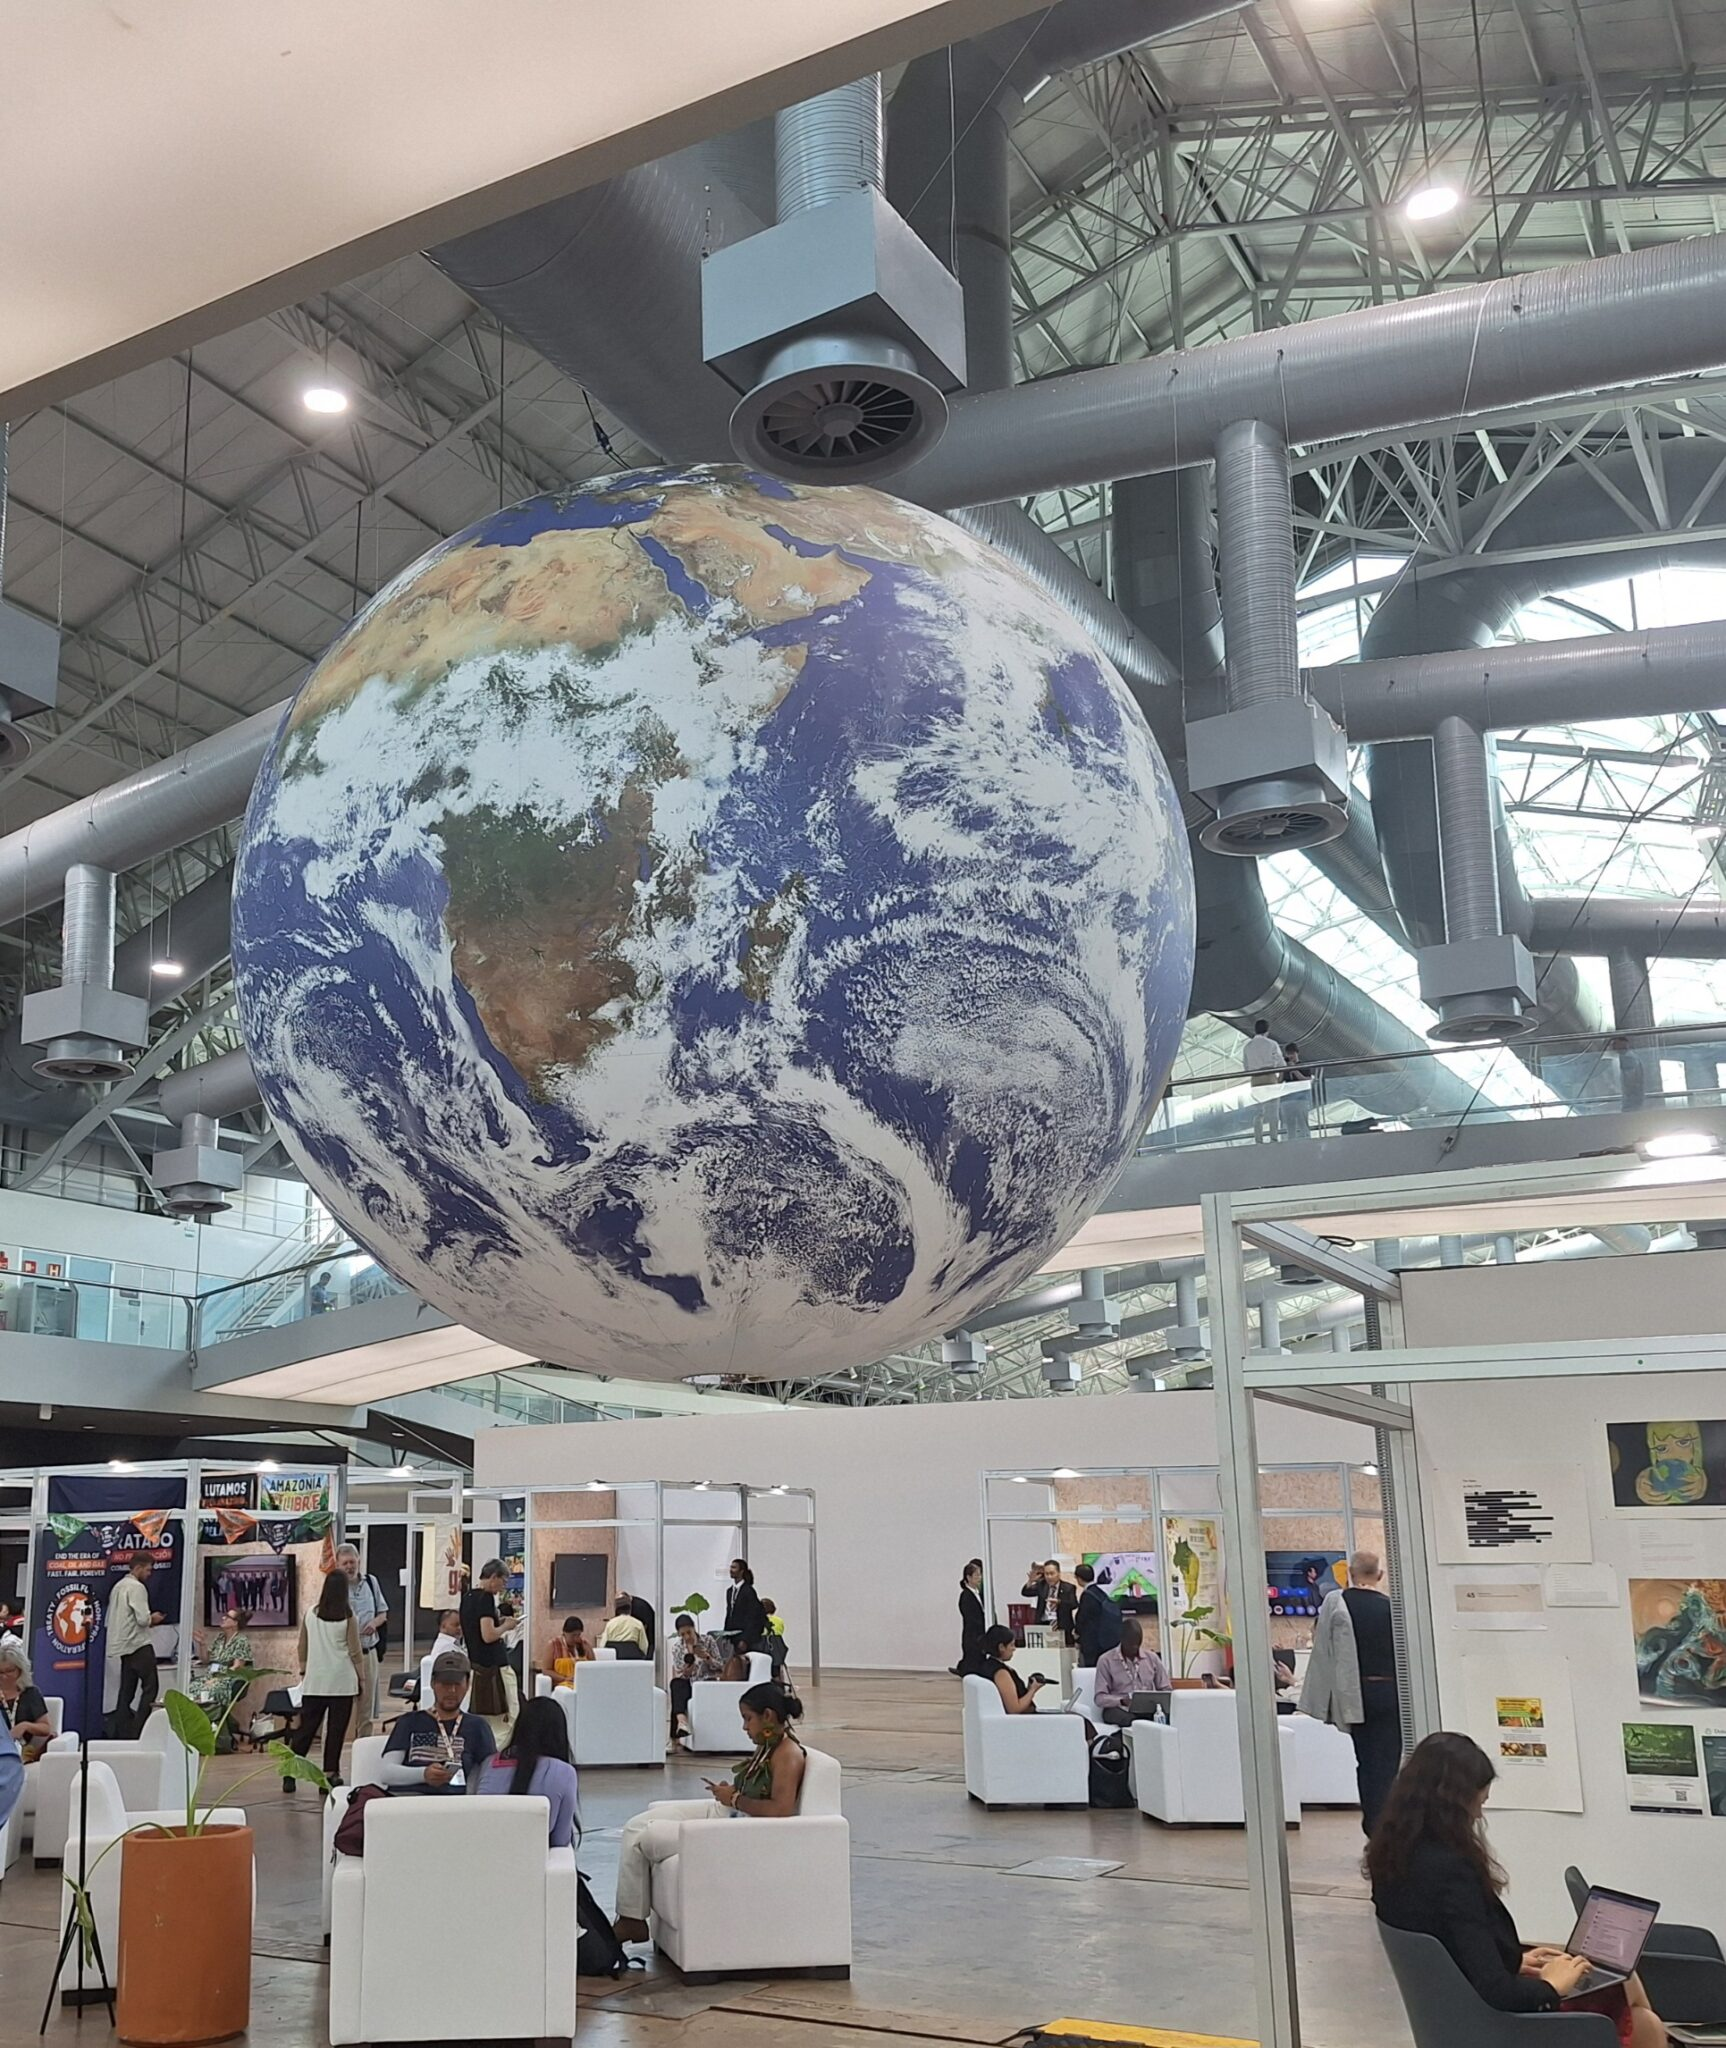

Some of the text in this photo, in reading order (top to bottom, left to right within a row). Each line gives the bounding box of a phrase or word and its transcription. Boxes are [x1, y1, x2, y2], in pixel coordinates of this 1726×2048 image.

[205, 1482, 247, 1497] LUTAMOS
[270, 1474, 321, 1492] AMAZONÍA
[68, 1552, 79, 1560] THE
[56, 1584, 80, 1600] FOSSIL
[46, 1601, 56, 1636] TREATY
